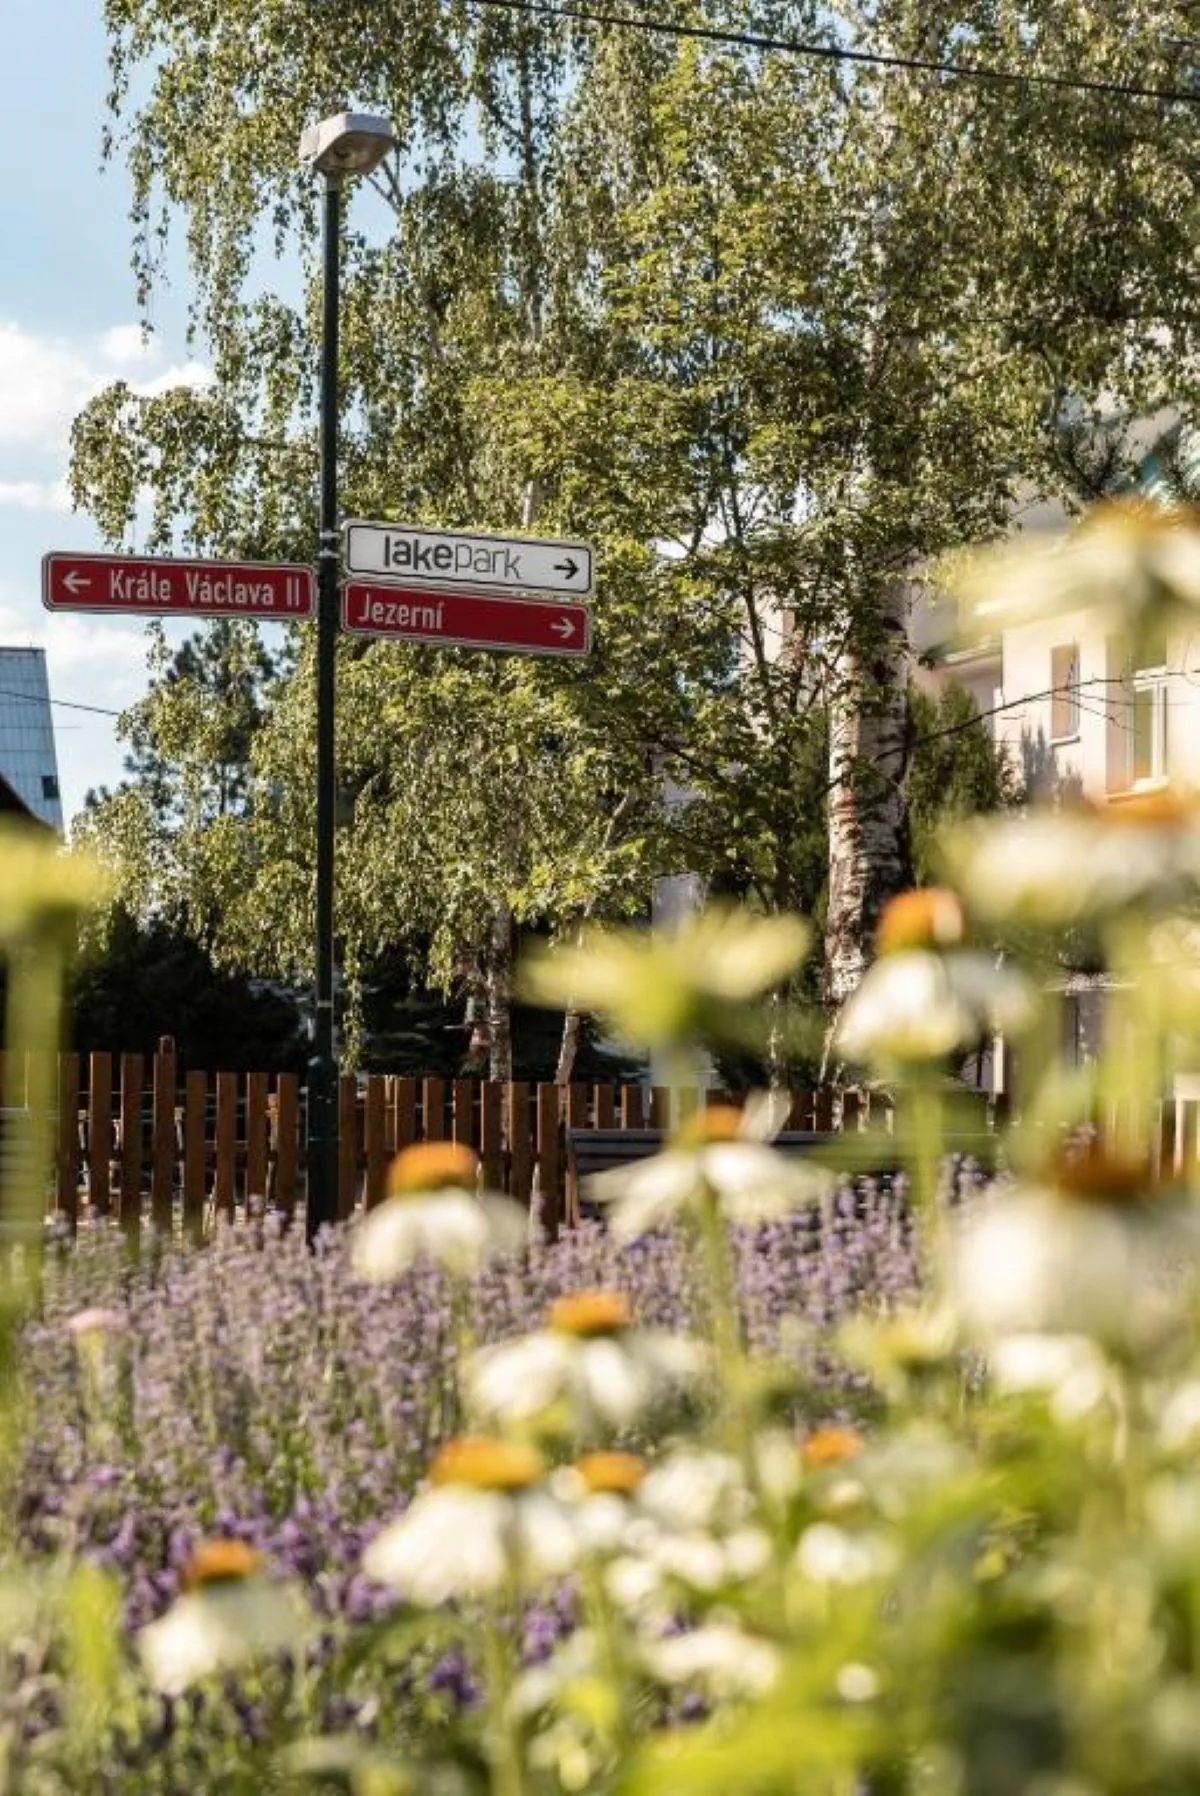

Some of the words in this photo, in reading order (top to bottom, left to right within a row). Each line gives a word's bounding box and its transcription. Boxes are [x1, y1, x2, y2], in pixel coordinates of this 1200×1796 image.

[110, 566, 172, 600] Krále
[184, 571, 275, 605] Václava
[286, 575, 300, 608] II
[357, 591, 445, 630] Jezerní
